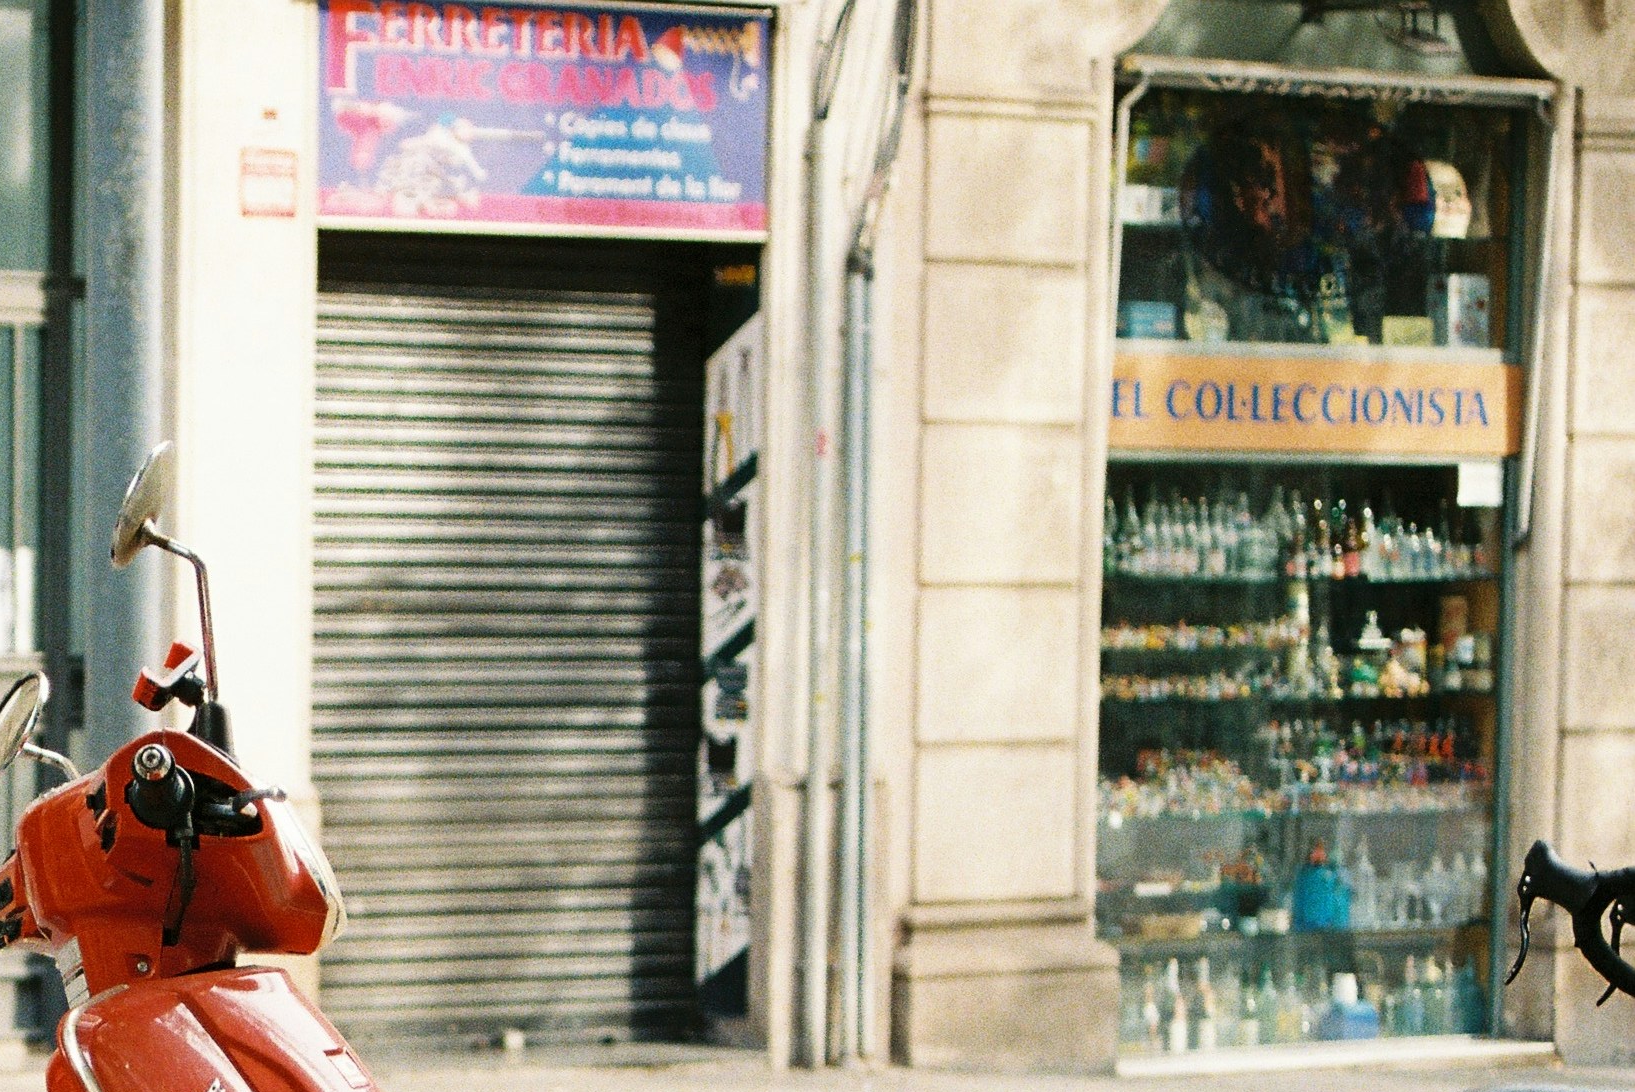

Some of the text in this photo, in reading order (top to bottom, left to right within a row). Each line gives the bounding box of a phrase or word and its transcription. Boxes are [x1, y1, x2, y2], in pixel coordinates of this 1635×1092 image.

[327, 0, 650, 96] FERRETERIA
[374, 55, 719, 112] ENRIC GRANADOS
[631, 116, 658, 139] de
[656, 174, 682, 198] de
[1111, 378, 1148, 421] EL
